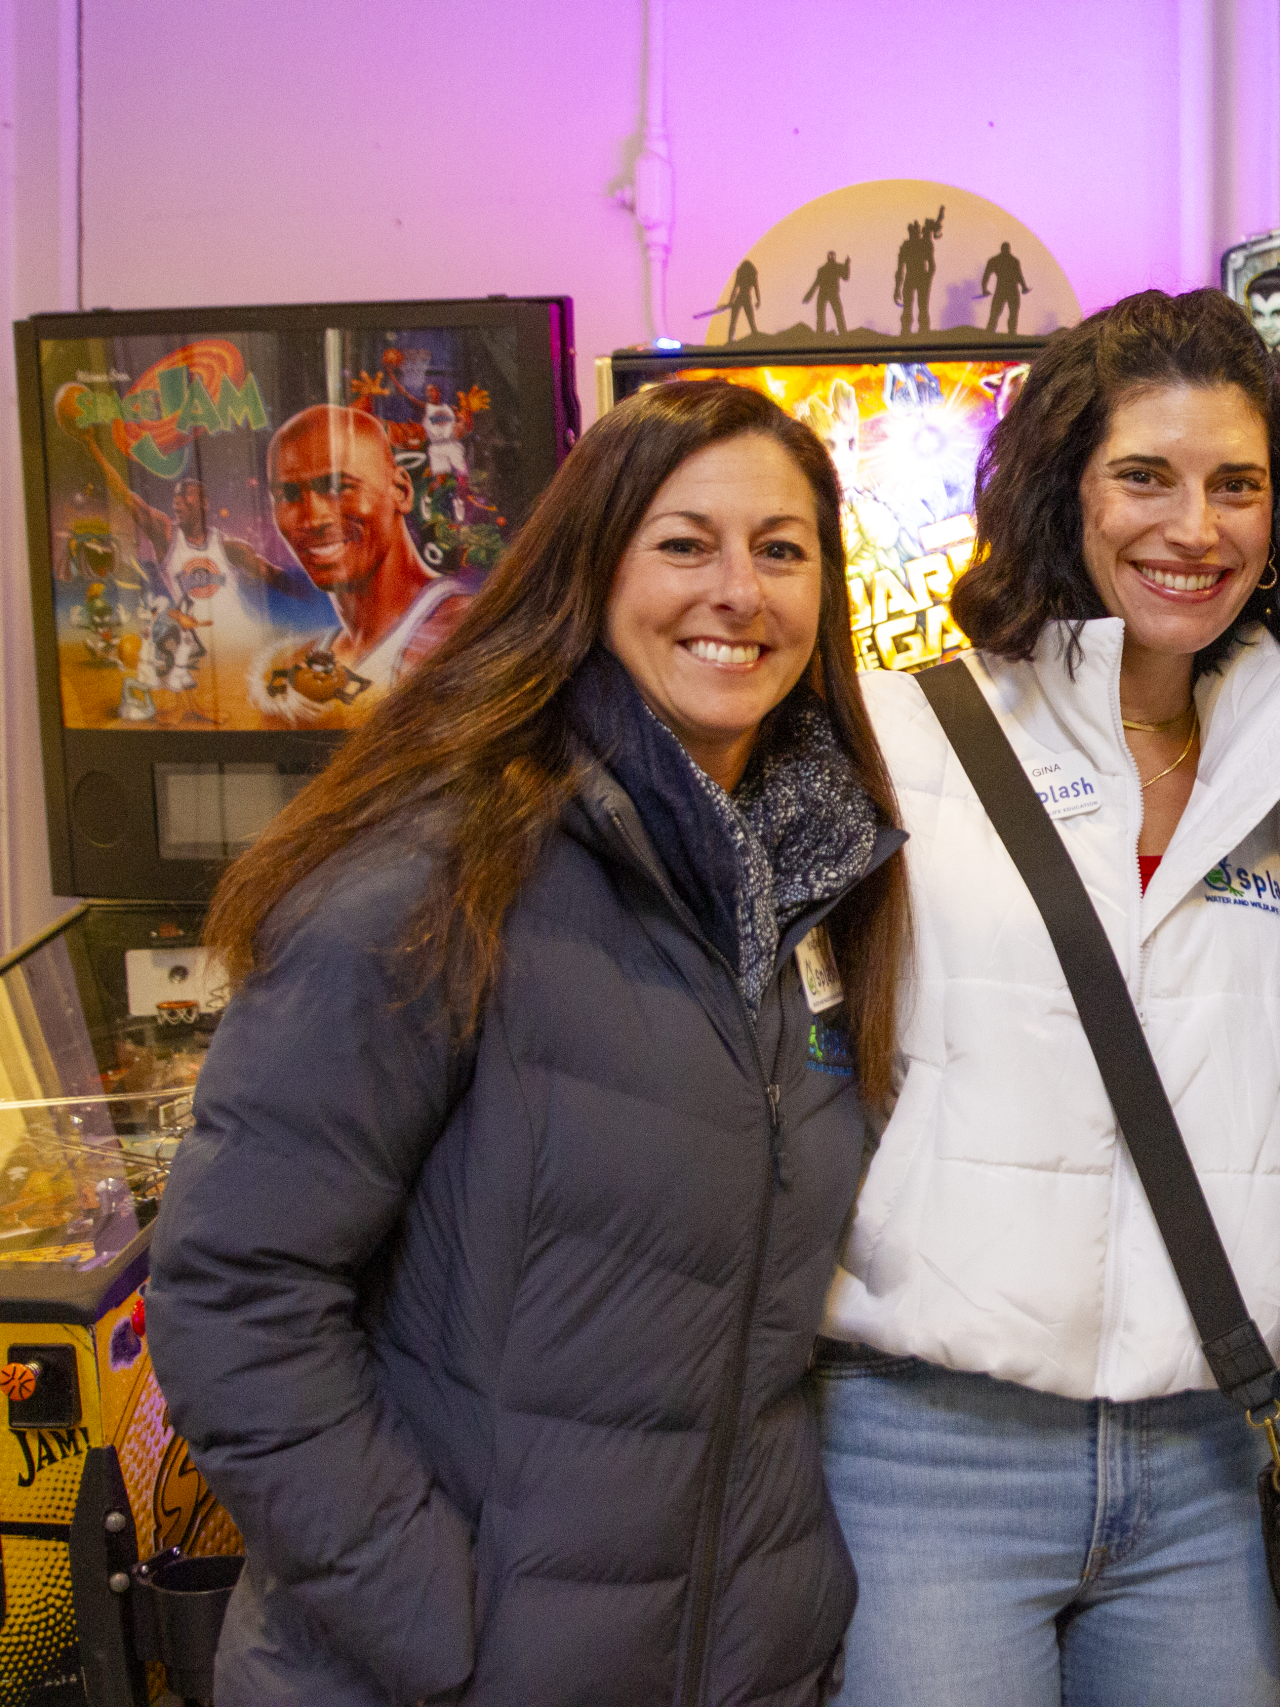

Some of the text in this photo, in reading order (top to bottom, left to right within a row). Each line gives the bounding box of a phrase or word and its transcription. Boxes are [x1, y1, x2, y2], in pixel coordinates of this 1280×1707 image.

[76, 364, 271, 481] SPACE JAM
[1032, 763, 1062, 777] GINA
[1036, 777, 1095, 803] plash
[1063, 800, 1099, 812] EDUCATION
[1205, 894, 1232, 904] WATER
[1233, 898, 1249, 906] AND
[8, 1426, 92, 1488] JAM!
